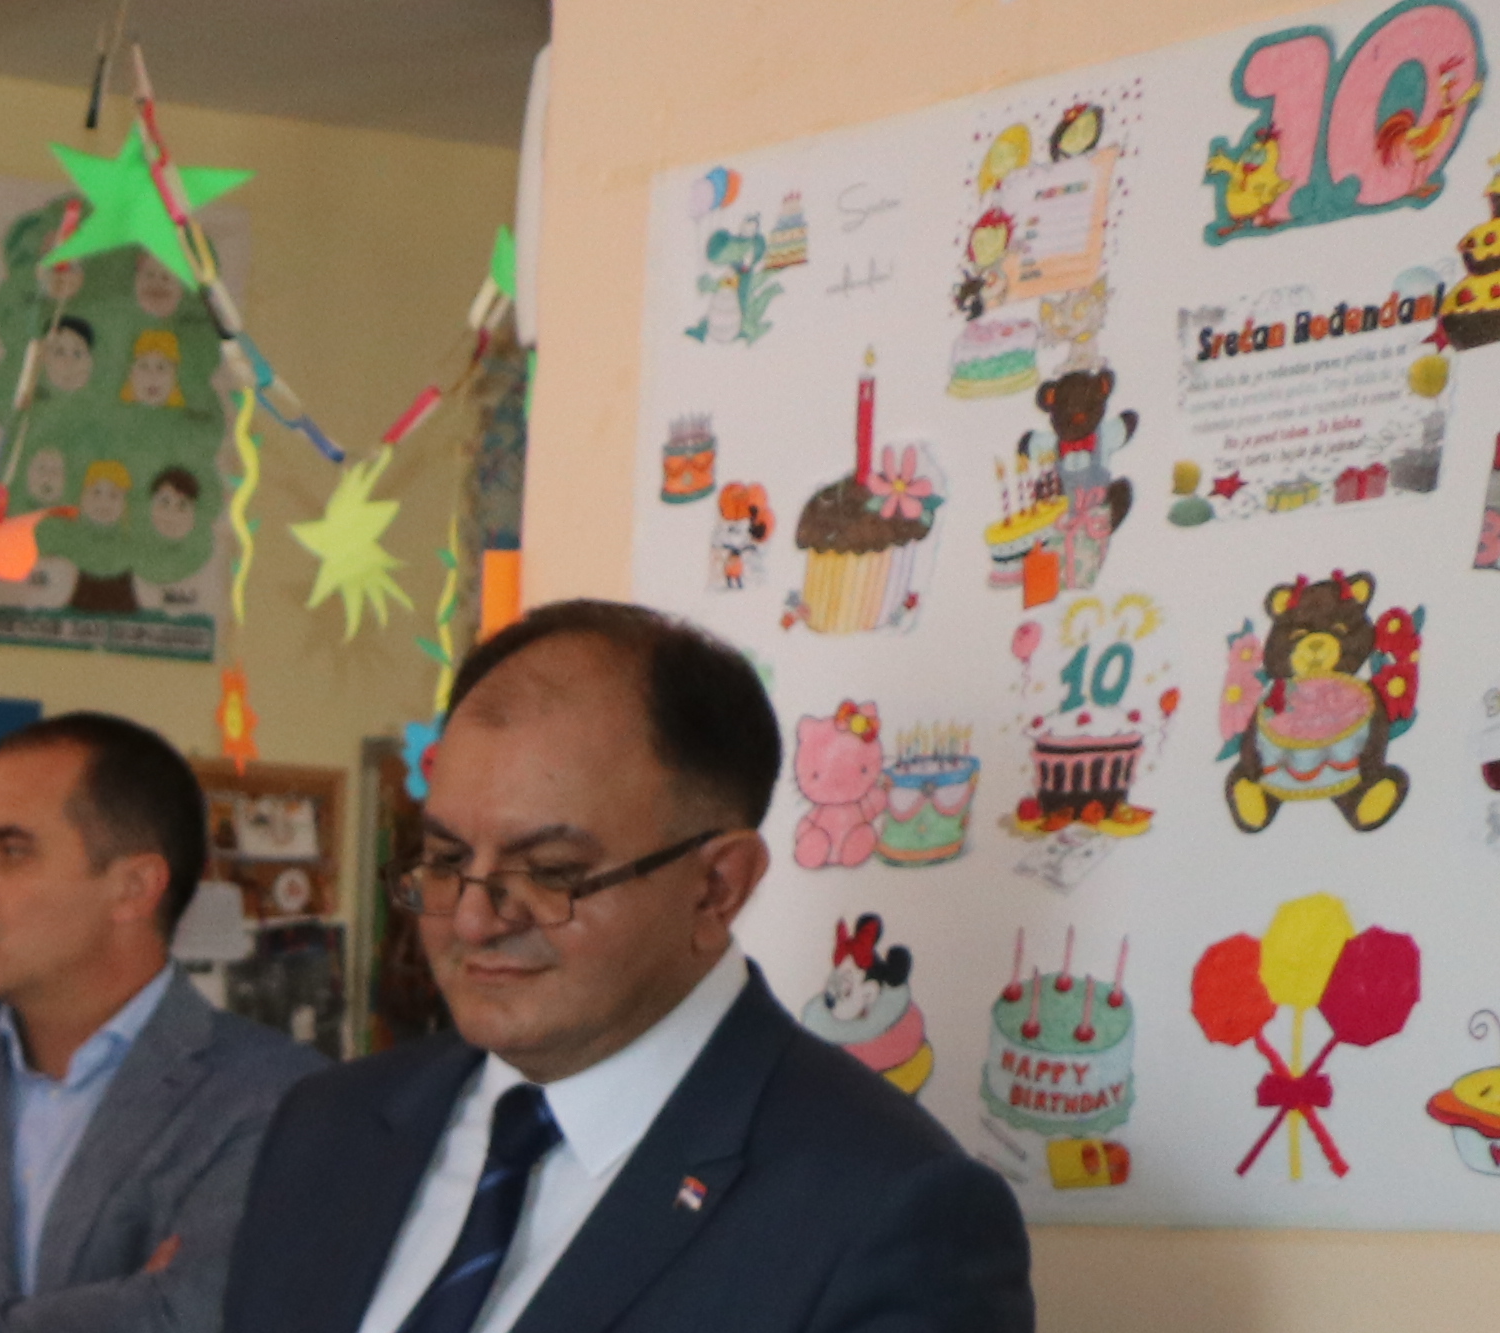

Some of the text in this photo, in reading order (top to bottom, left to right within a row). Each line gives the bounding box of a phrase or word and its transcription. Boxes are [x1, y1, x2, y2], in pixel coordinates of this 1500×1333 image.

[1232, 0, 1486, 226] 10
[1197, 317, 1286, 361] Srećan
[1060, 643, 1134, 714] 10
[1001, 1050, 1090, 1085] HAPPY
[1010, 1081, 1125, 1114] BIRTHDAY
